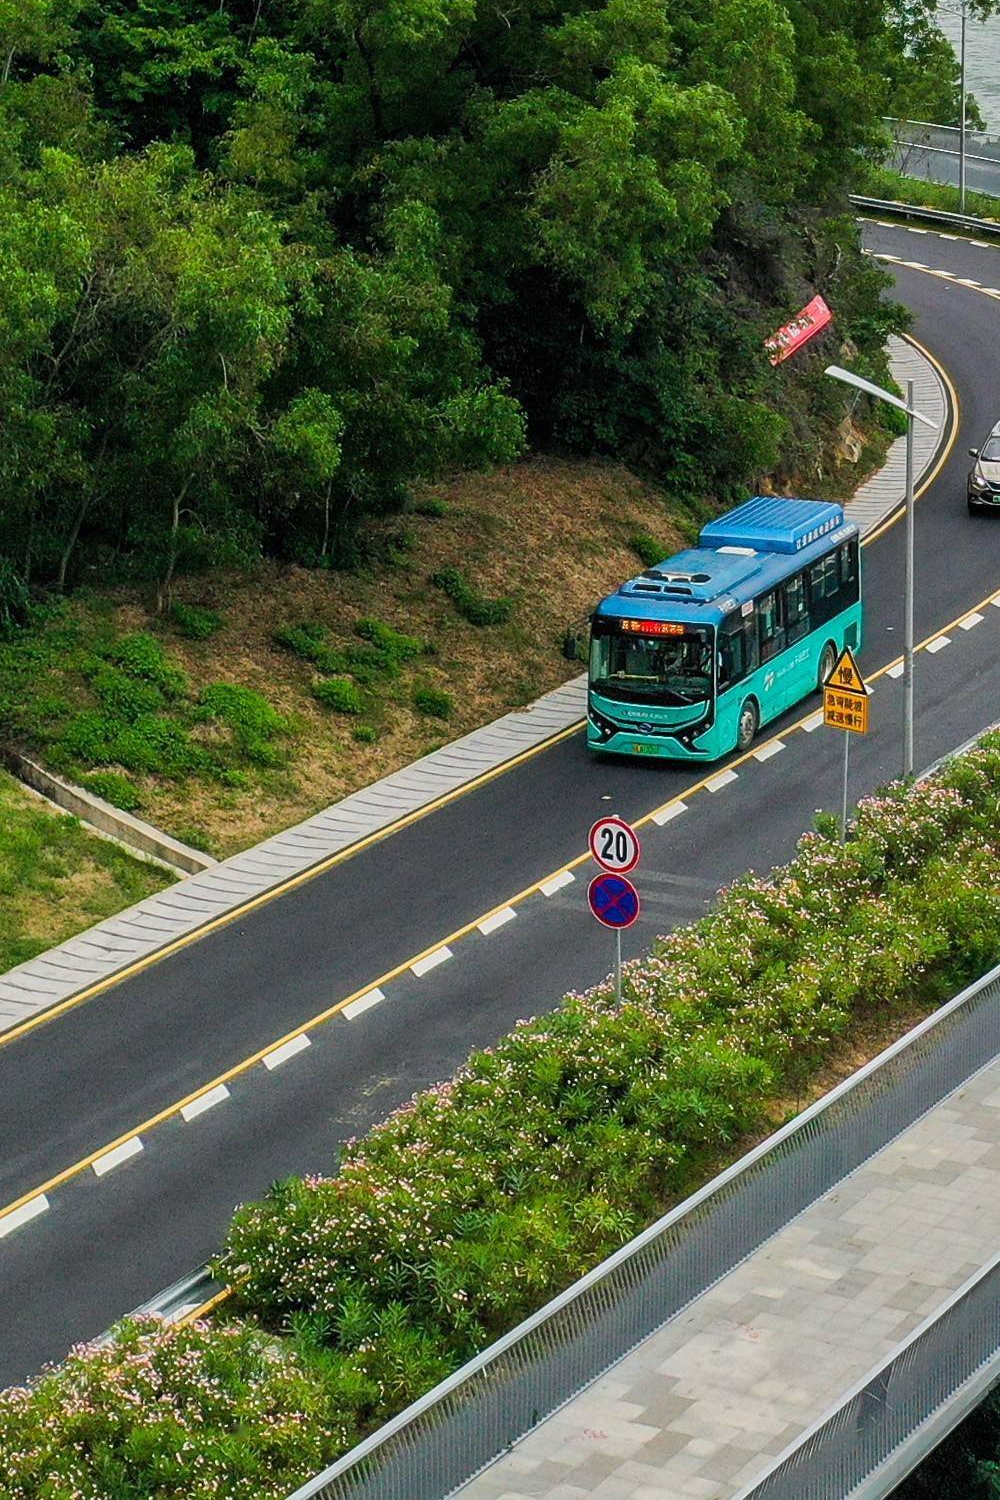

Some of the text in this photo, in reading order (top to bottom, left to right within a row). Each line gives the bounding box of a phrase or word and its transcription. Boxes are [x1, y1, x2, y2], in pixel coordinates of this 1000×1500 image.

[838, 667, 853, 686] 慢
[827, 710, 863, 728] 减速慢行
[600, 827, 628, 863] 20
